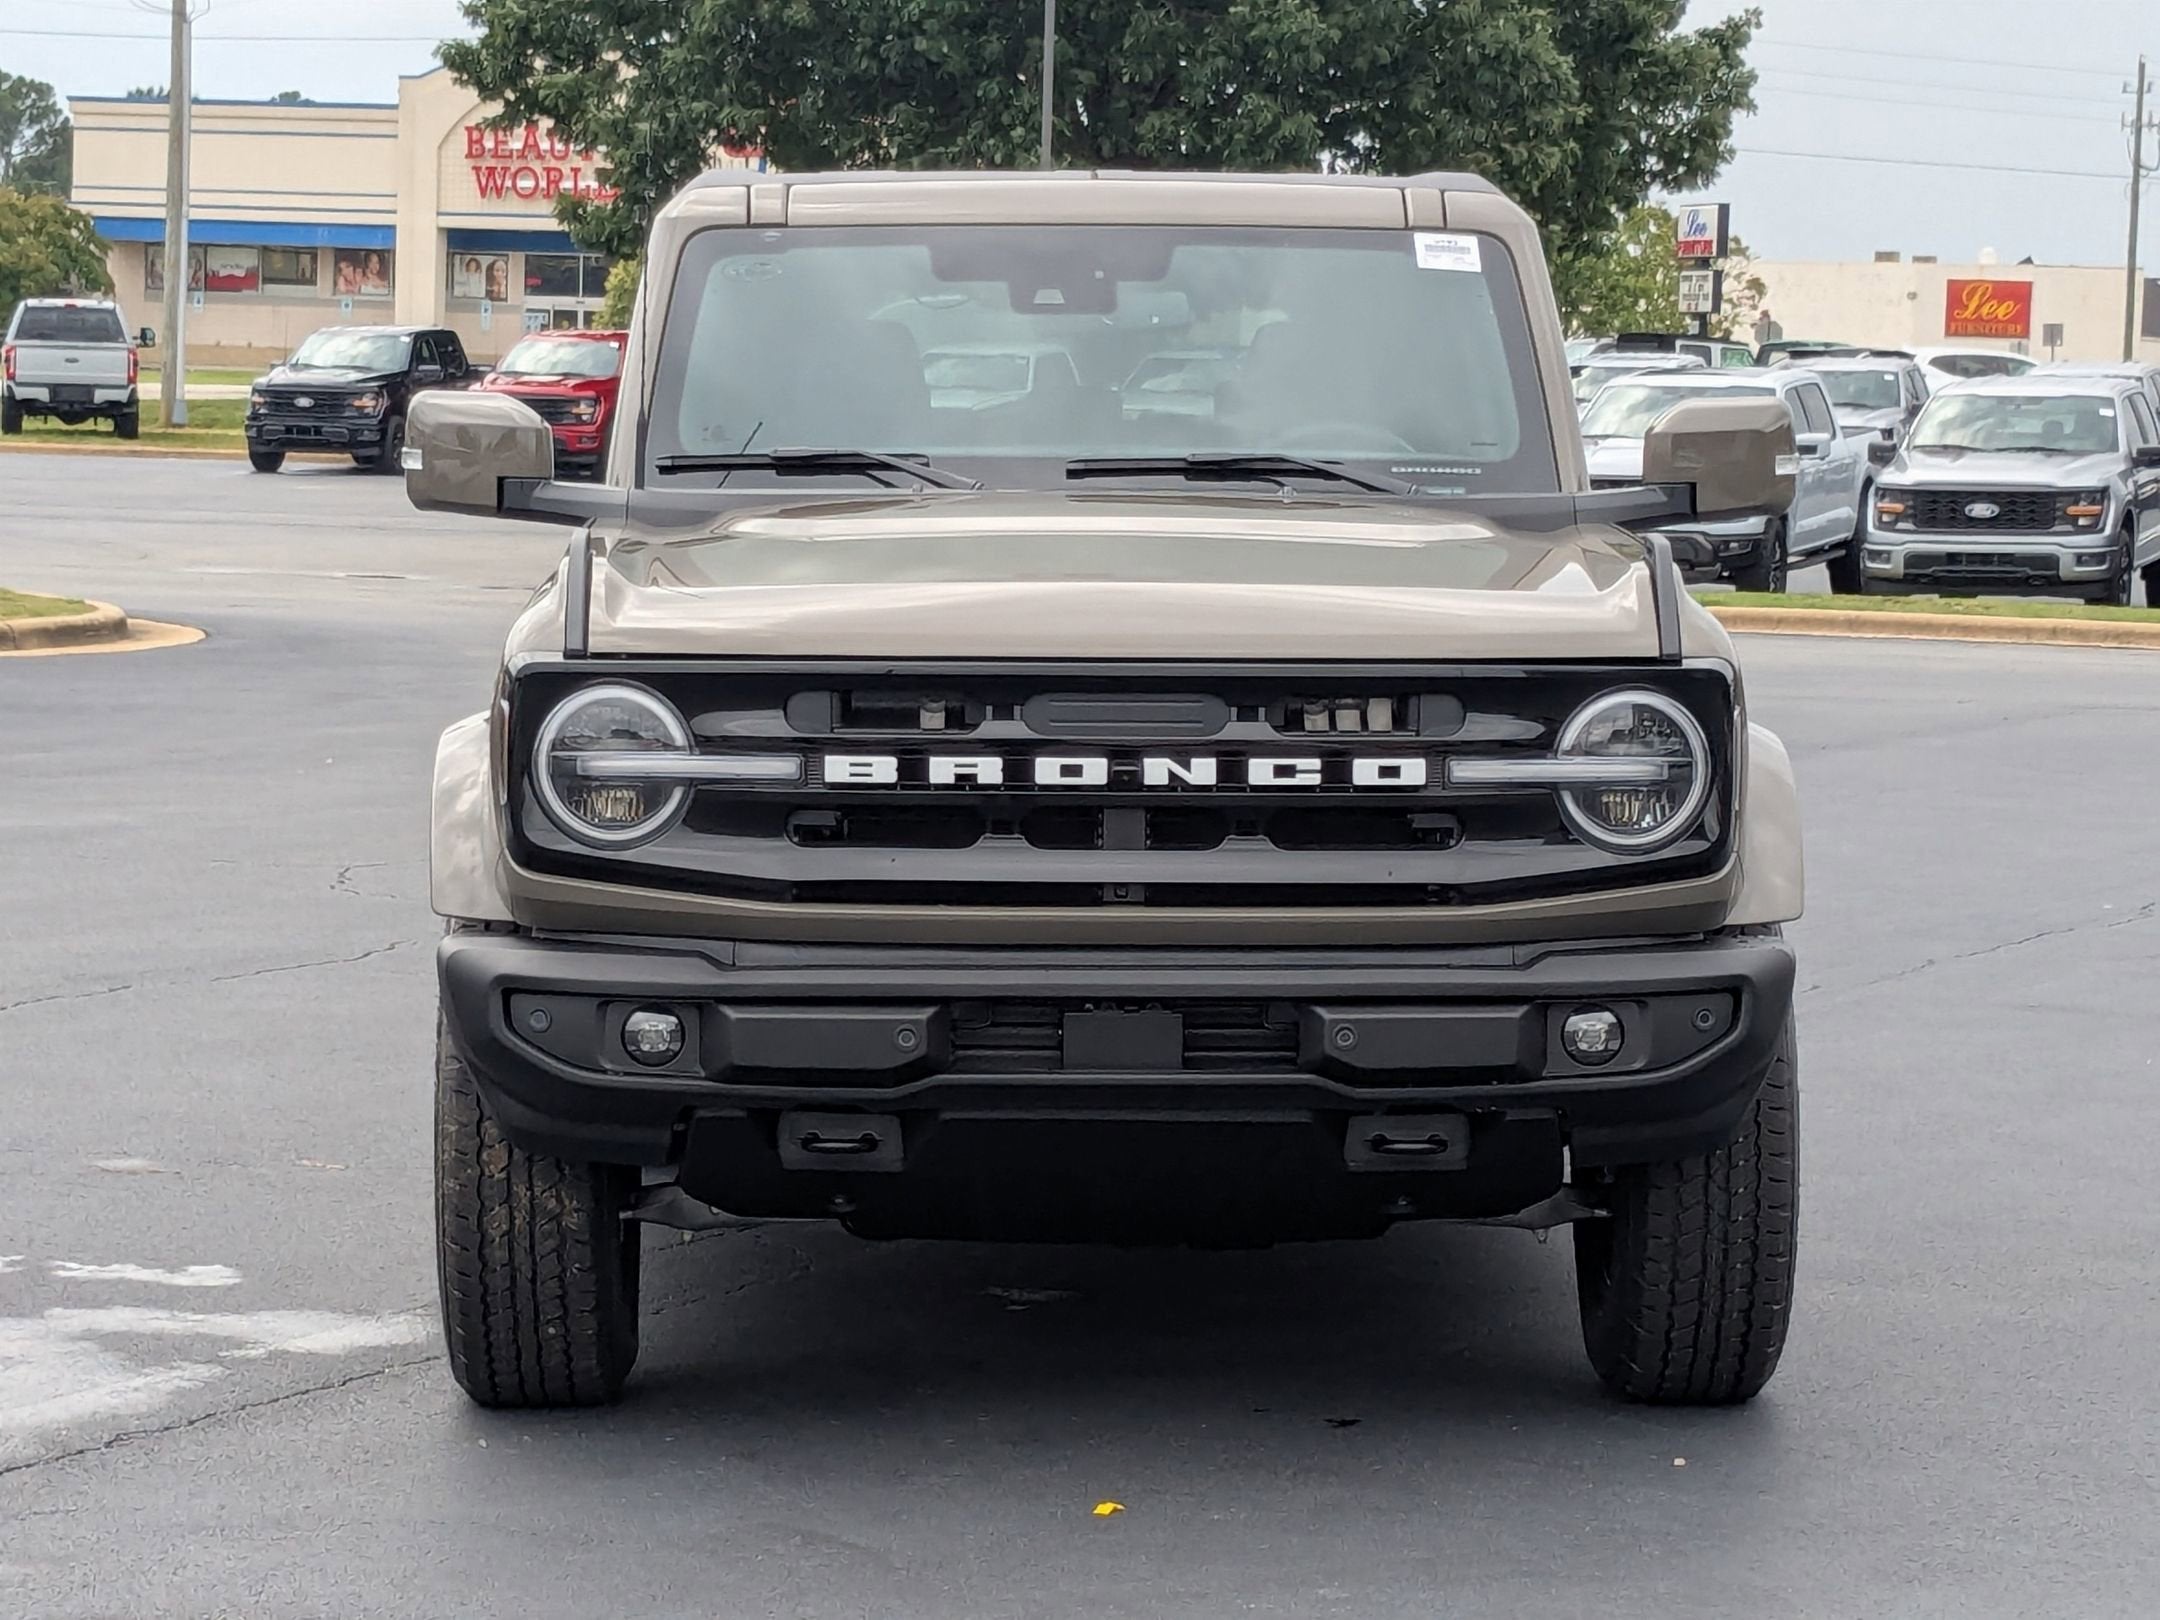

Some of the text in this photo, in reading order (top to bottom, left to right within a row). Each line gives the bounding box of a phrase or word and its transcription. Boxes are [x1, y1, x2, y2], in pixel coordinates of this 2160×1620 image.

[464, 121, 595, 162] BEAU
[1954, 282, 2021, 320] Lee
[823, 756, 1427, 786] BRONCO
